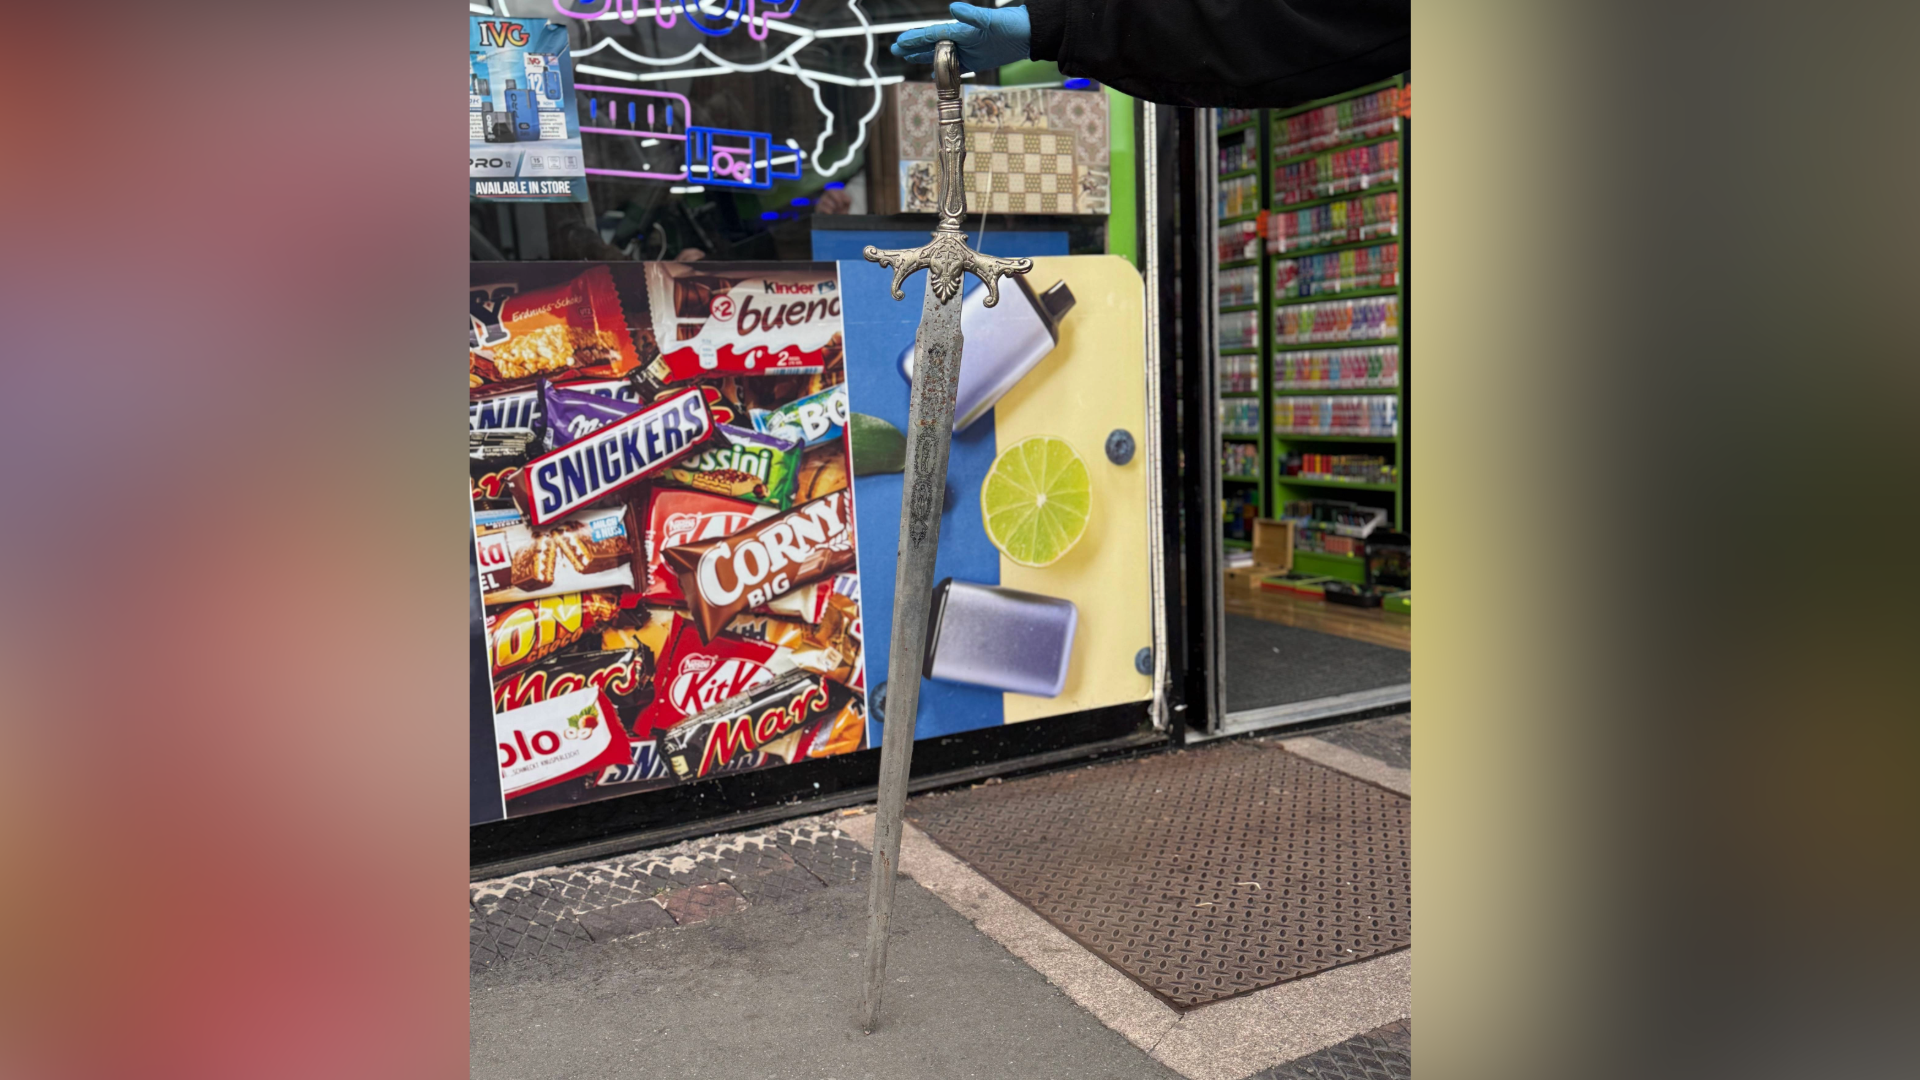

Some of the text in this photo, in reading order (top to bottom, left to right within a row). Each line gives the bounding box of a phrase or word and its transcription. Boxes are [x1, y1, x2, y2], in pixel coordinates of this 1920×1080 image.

[478, 22, 530, 47] IVG
[528, 73, 545, 95] 12
[475, 180, 571, 195] AVAILABLE IN STORE
[776, 350, 790, 367] 2
[537, 394, 704, 516] SNICKERS
[697, 492, 844, 607] CORNY
[747, 572, 790, 609] BIG
[487, 592, 583, 668] ON
[527, 626, 583, 663] CHOCO
[494, 658, 642, 713] Mars
[697, 677, 829, 779] Mars
